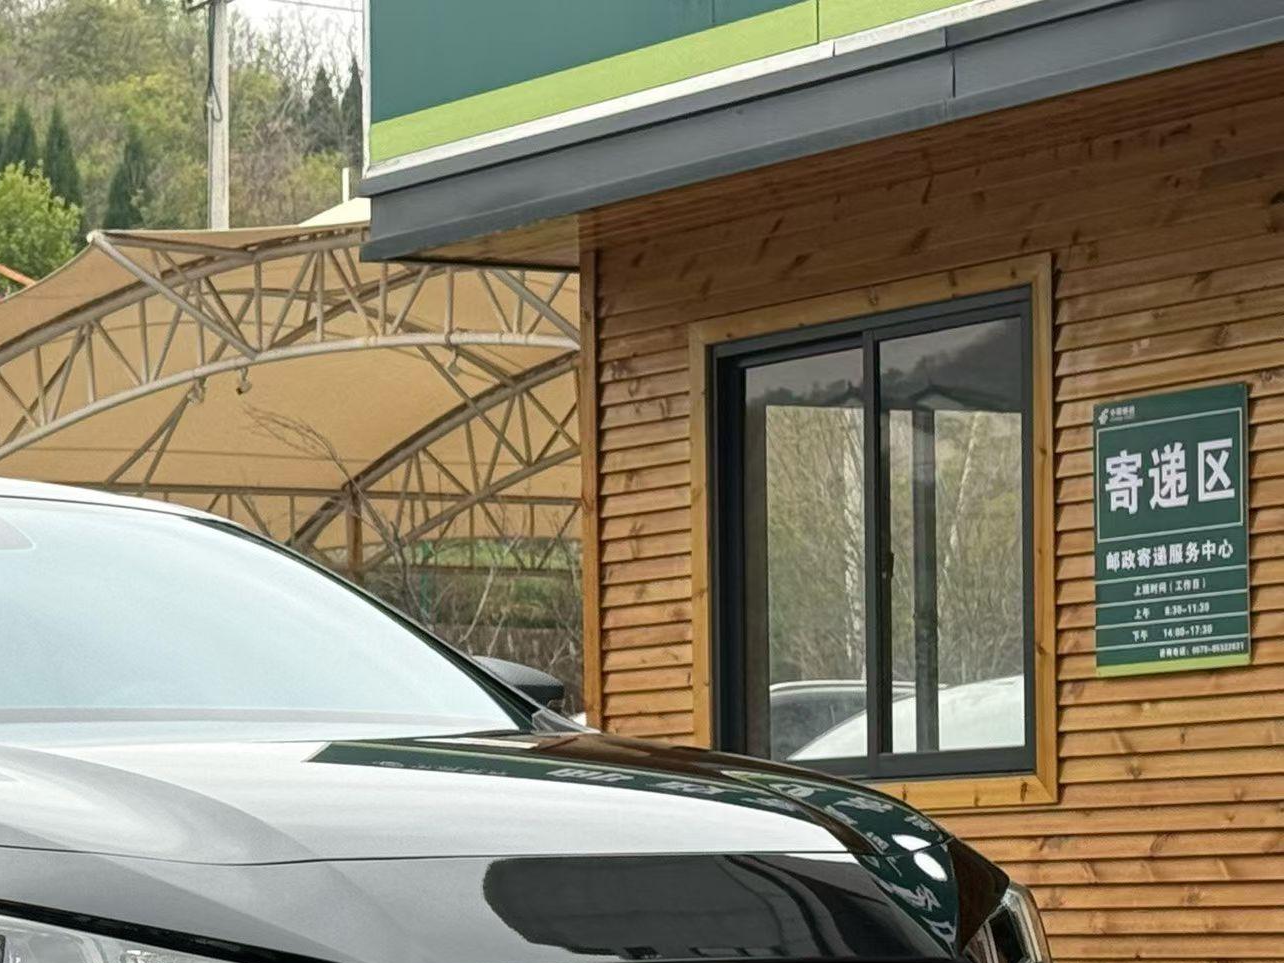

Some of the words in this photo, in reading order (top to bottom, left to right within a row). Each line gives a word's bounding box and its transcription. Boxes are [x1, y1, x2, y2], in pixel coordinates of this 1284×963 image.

[1104, 438, 1235, 515] 寄递区
[1105, 539, 1234, 572] 邮政寄递服务中心
[1133, 607, 1150, 620] 上午
[1132, 629, 1148, 643] 下午
